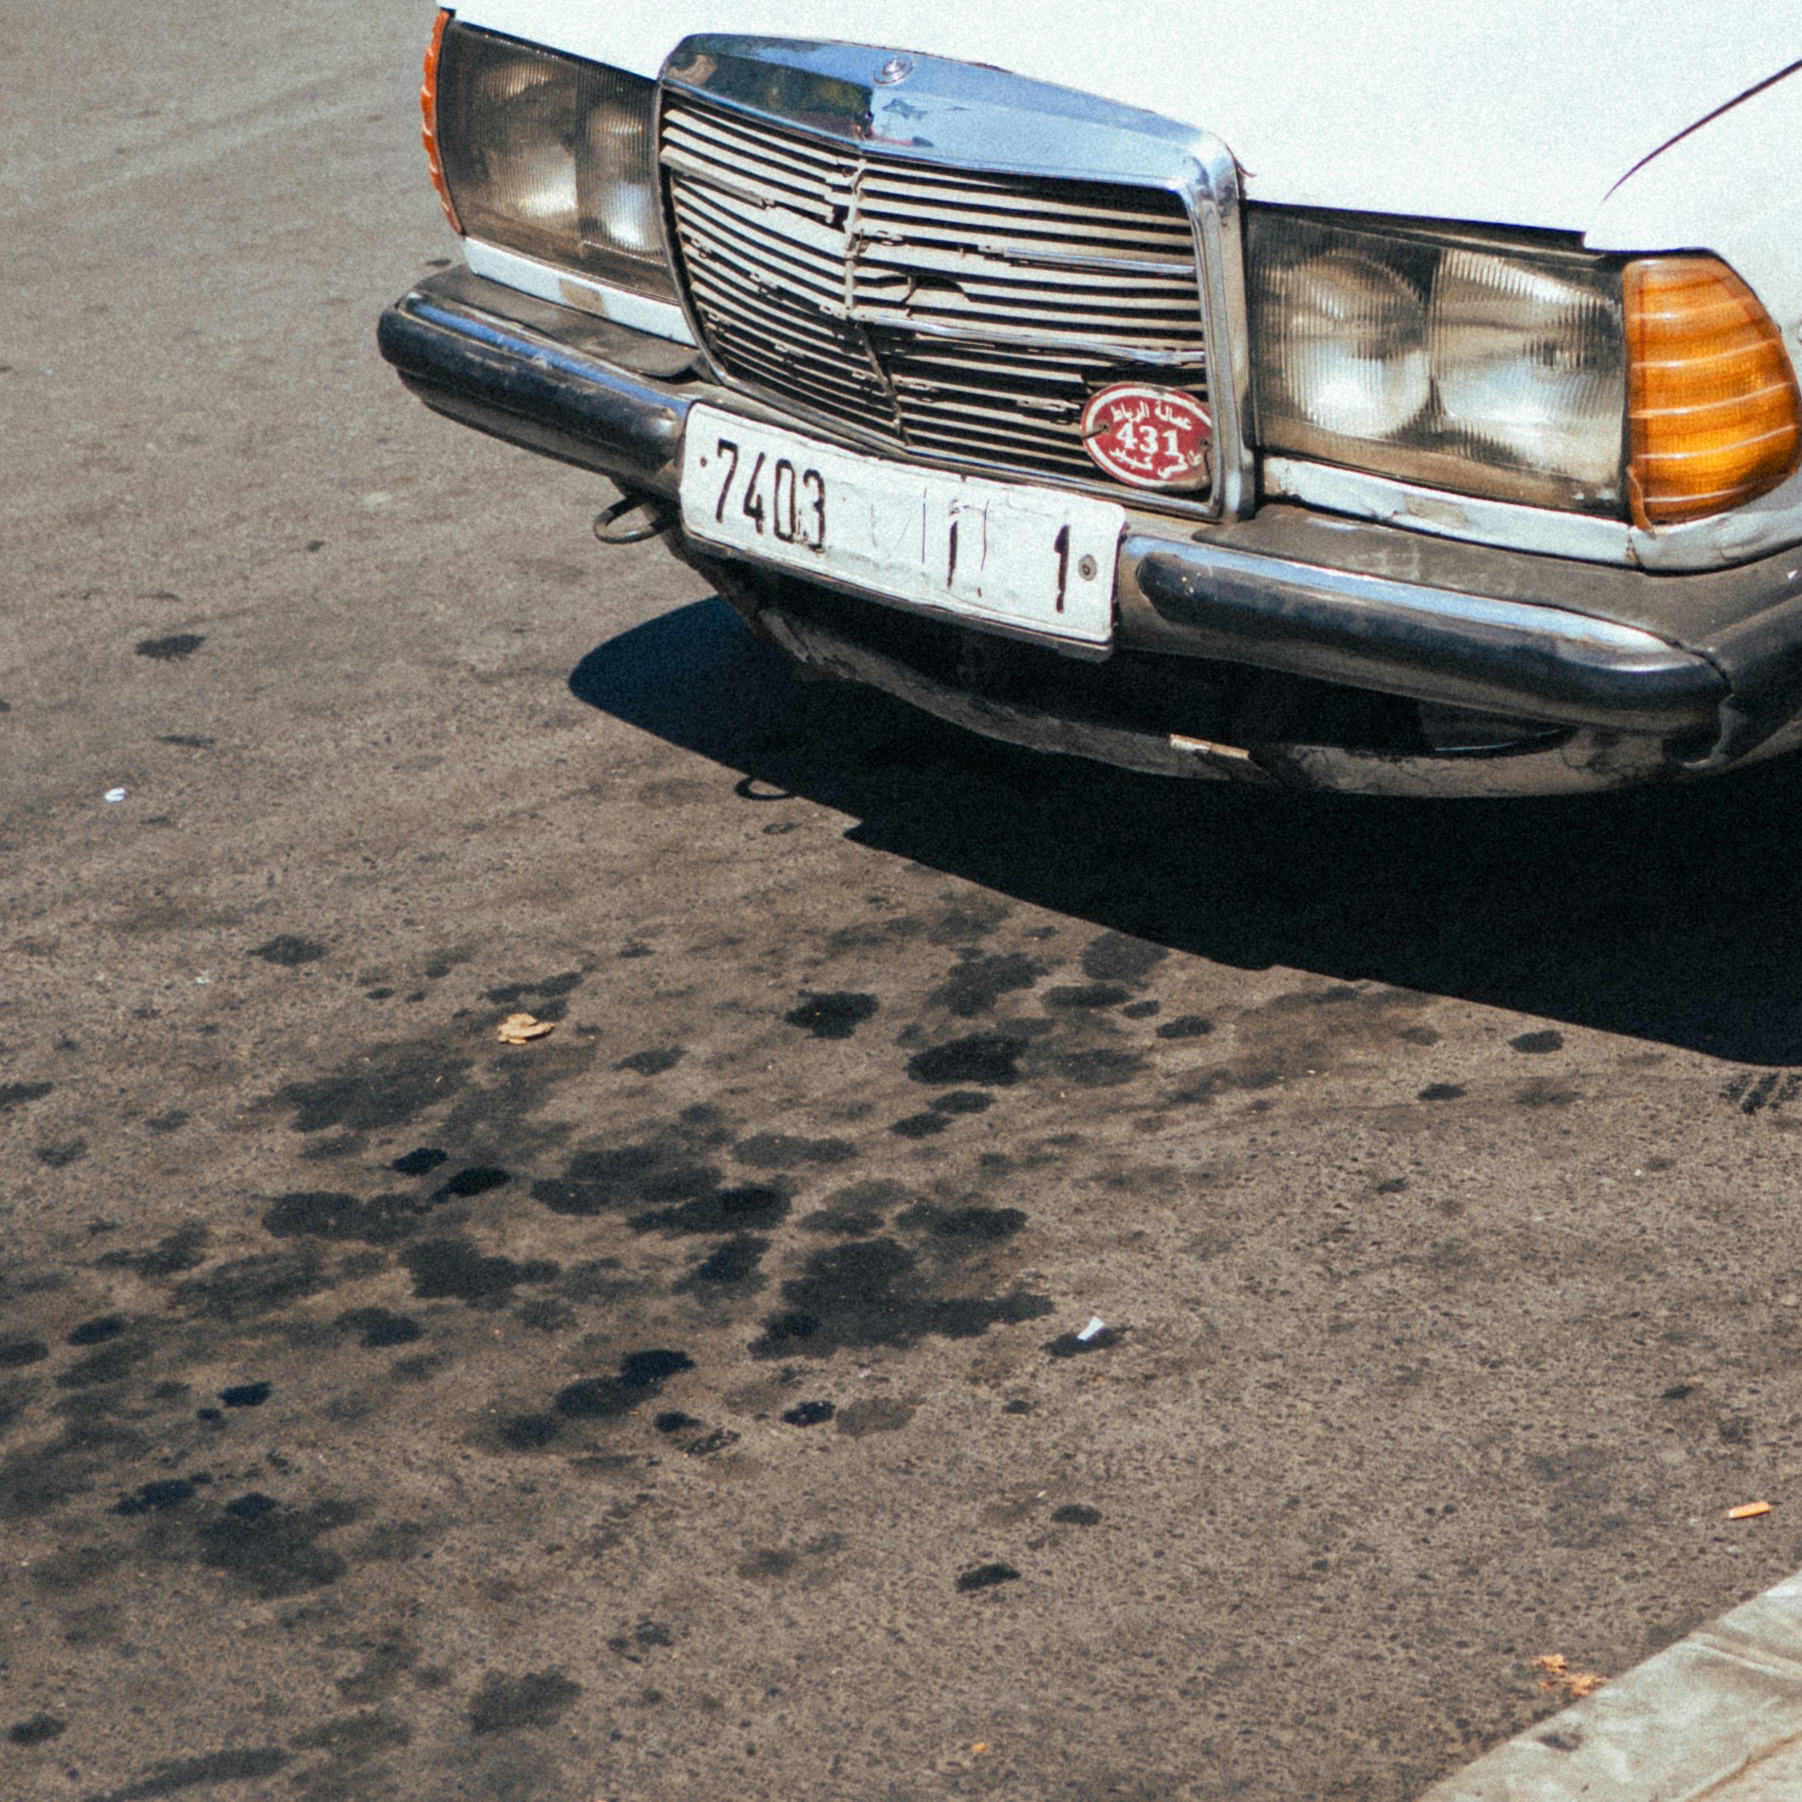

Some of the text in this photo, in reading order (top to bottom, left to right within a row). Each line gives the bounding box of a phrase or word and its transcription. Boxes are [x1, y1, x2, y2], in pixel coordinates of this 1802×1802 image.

[1110, 400, 1193, 431] عمالة الرباط
[1115, 422, 1180, 456] 431
[715, 438, 827, 553] 7403
